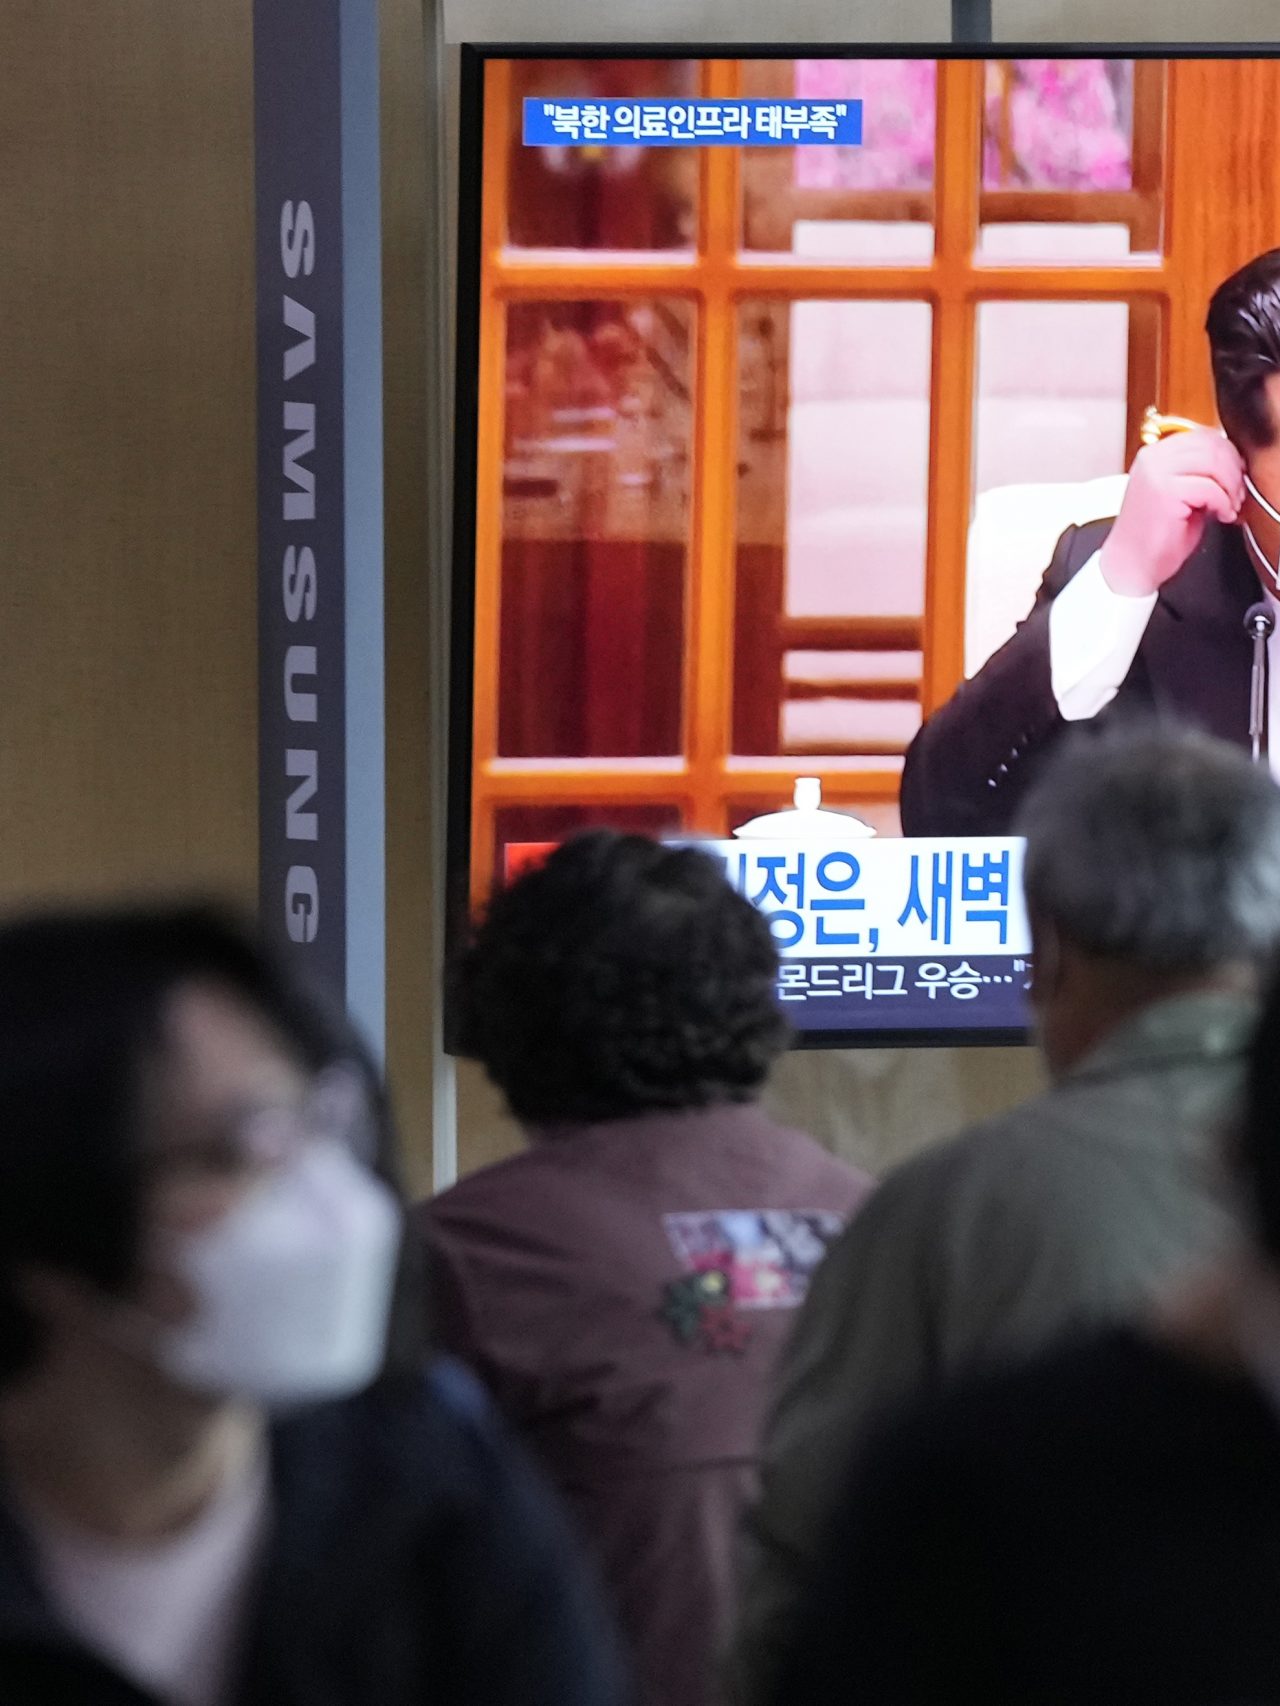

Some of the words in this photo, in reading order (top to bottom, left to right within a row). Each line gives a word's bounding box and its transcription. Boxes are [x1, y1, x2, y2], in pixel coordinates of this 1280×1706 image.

[543, 103, 610, 140] "북한
[612, 105, 752, 140] 의료인프라
[755, 103, 848, 140] 태부족"
[279, 197, 321, 944] SAMSUNG
[897, 851, 1010, 946] 새벽
[915, 960, 1033, 1001] 우승…"
